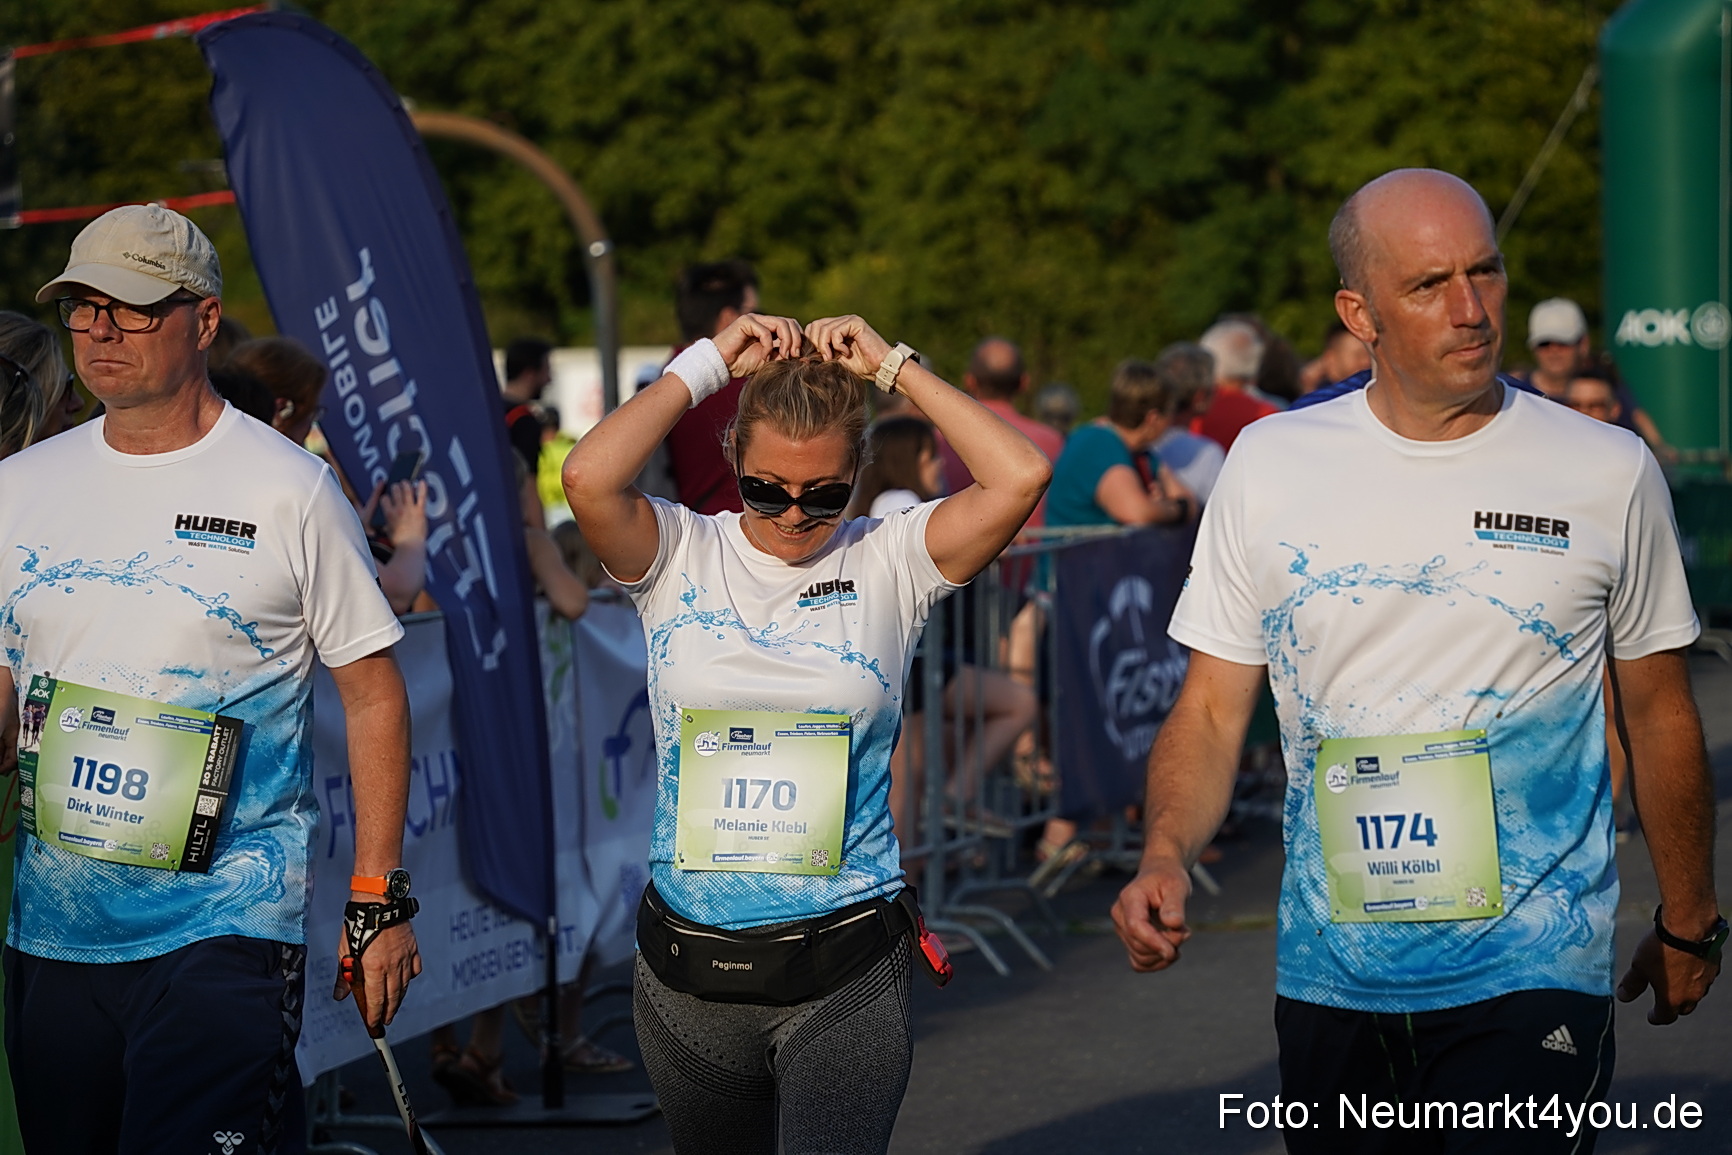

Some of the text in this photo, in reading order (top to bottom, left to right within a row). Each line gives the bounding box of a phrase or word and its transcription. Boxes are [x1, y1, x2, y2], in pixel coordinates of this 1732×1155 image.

[131, 253, 166, 270] Columbia
[1614, 308, 1692, 348] AOK
[174, 513, 257, 540] HUBER
[1474, 510, 1570, 539] HUBER
[189, 532, 252, 547] TECHNOLOGY
[1493, 532, 1566, 547] TECHNOLOGY
[228, 546, 250, 555] Solutions
[810, 592, 855, 606] TECHNOOGY
[30, 688, 50, 699] AOK
[81, 721, 130, 736] Firmenlauf
[98, 732, 127, 741] neumarkt
[202, 724, 222, 786] 20 % RABATT
[721, 742, 772, 751] Firmenlauf
[211, 755, 223, 787] FACTORY
[218, 727, 230, 755] OUTLET
[71, 756, 149, 801] 1198
[1350, 771, 1400, 785] Firmenlauf
[1370, 781, 1399, 789] neumarkt
[721, 778, 797, 811] 1170
[66, 797, 144, 824] Dirk Winter
[713, 818, 807, 834] Melanie Klebl
[1356, 813, 1438, 850] 1174
[187, 819, 208, 863] HILTL
[1367, 859, 1441, 876] Willi Kölbl
[351, 909, 366, 950] LEKI
[712, 960, 753, 971] Peginmol
[1541, 1039, 1578, 1056] adidas
